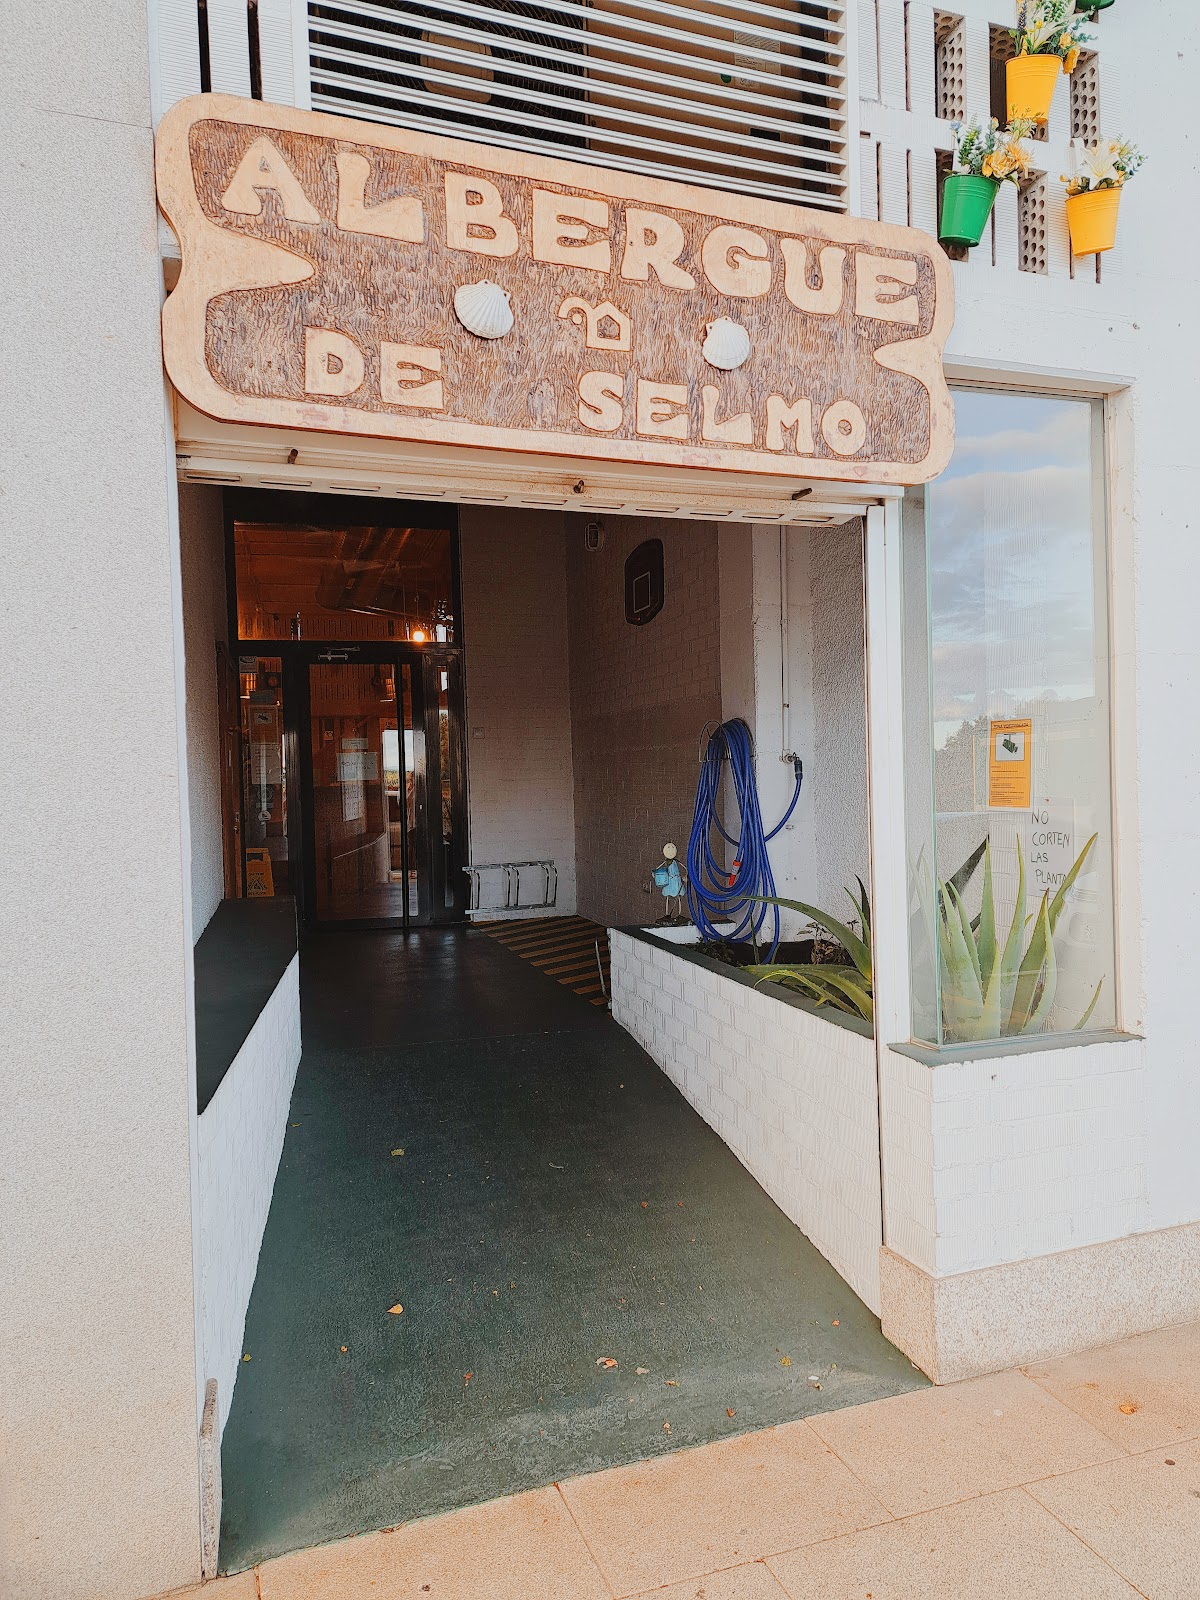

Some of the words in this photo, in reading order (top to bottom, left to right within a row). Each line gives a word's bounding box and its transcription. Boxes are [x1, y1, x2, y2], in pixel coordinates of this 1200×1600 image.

[221, 133, 920, 326] ALBERGUE
[305, 326, 444, 409] DE
[578, 371, 867, 455] SELMO
[1031, 808, 1049, 825] NO
[1032, 831, 1071, 848] CORTEN
[1031, 852, 1049, 863] LAS
